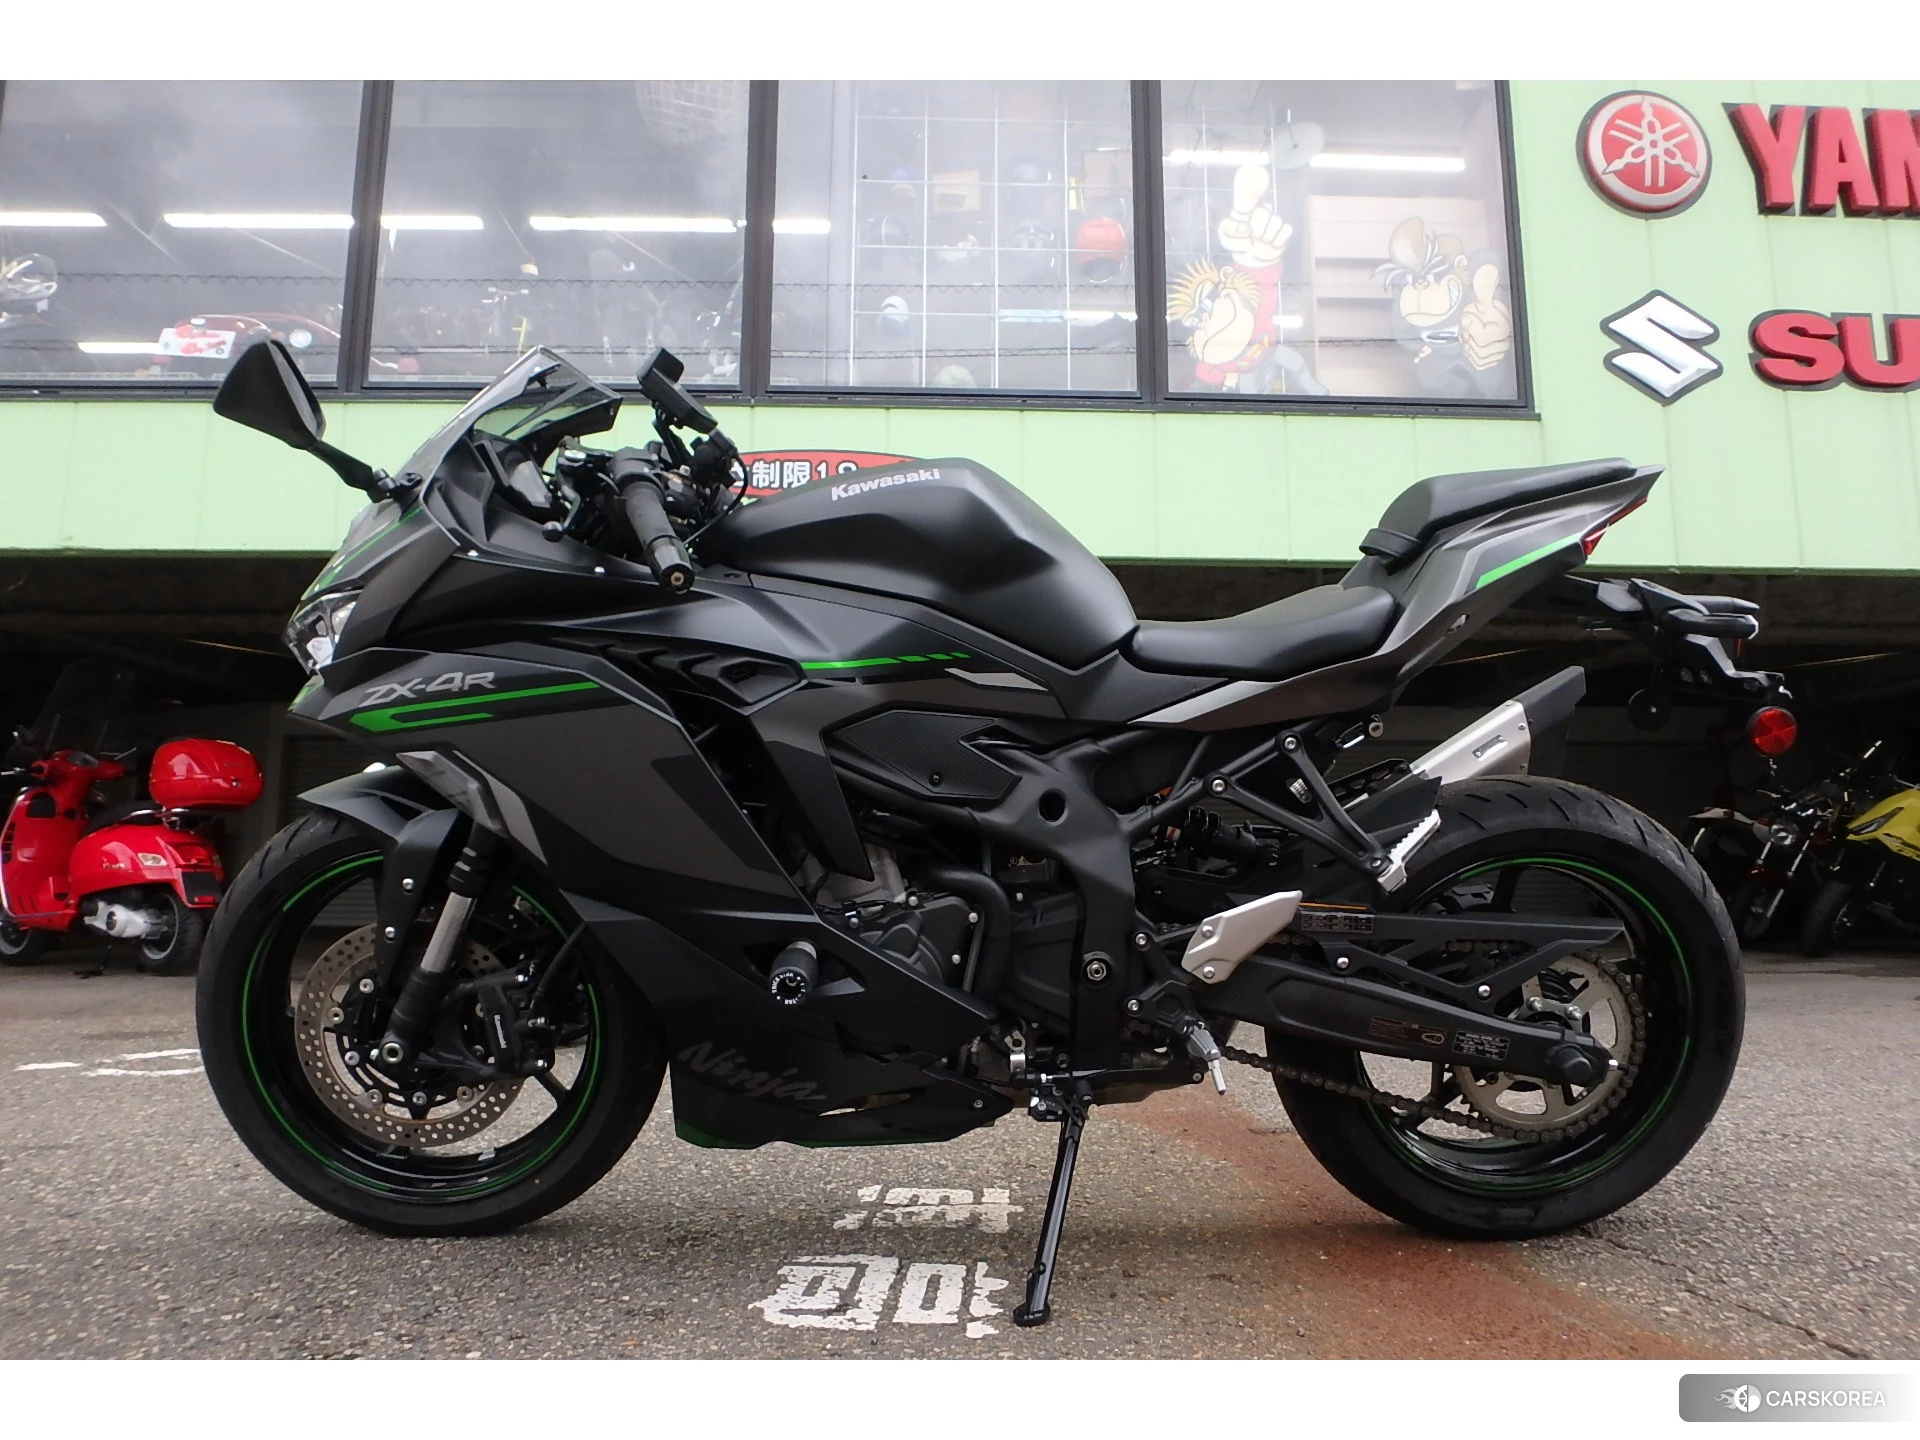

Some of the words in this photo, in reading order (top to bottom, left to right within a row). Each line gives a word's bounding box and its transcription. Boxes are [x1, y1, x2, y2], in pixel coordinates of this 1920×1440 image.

[831, 468, 941, 502] Kawasaki
[357, 671, 497, 708] ZX-4R
[676, 1039, 828, 1101] Ninja
